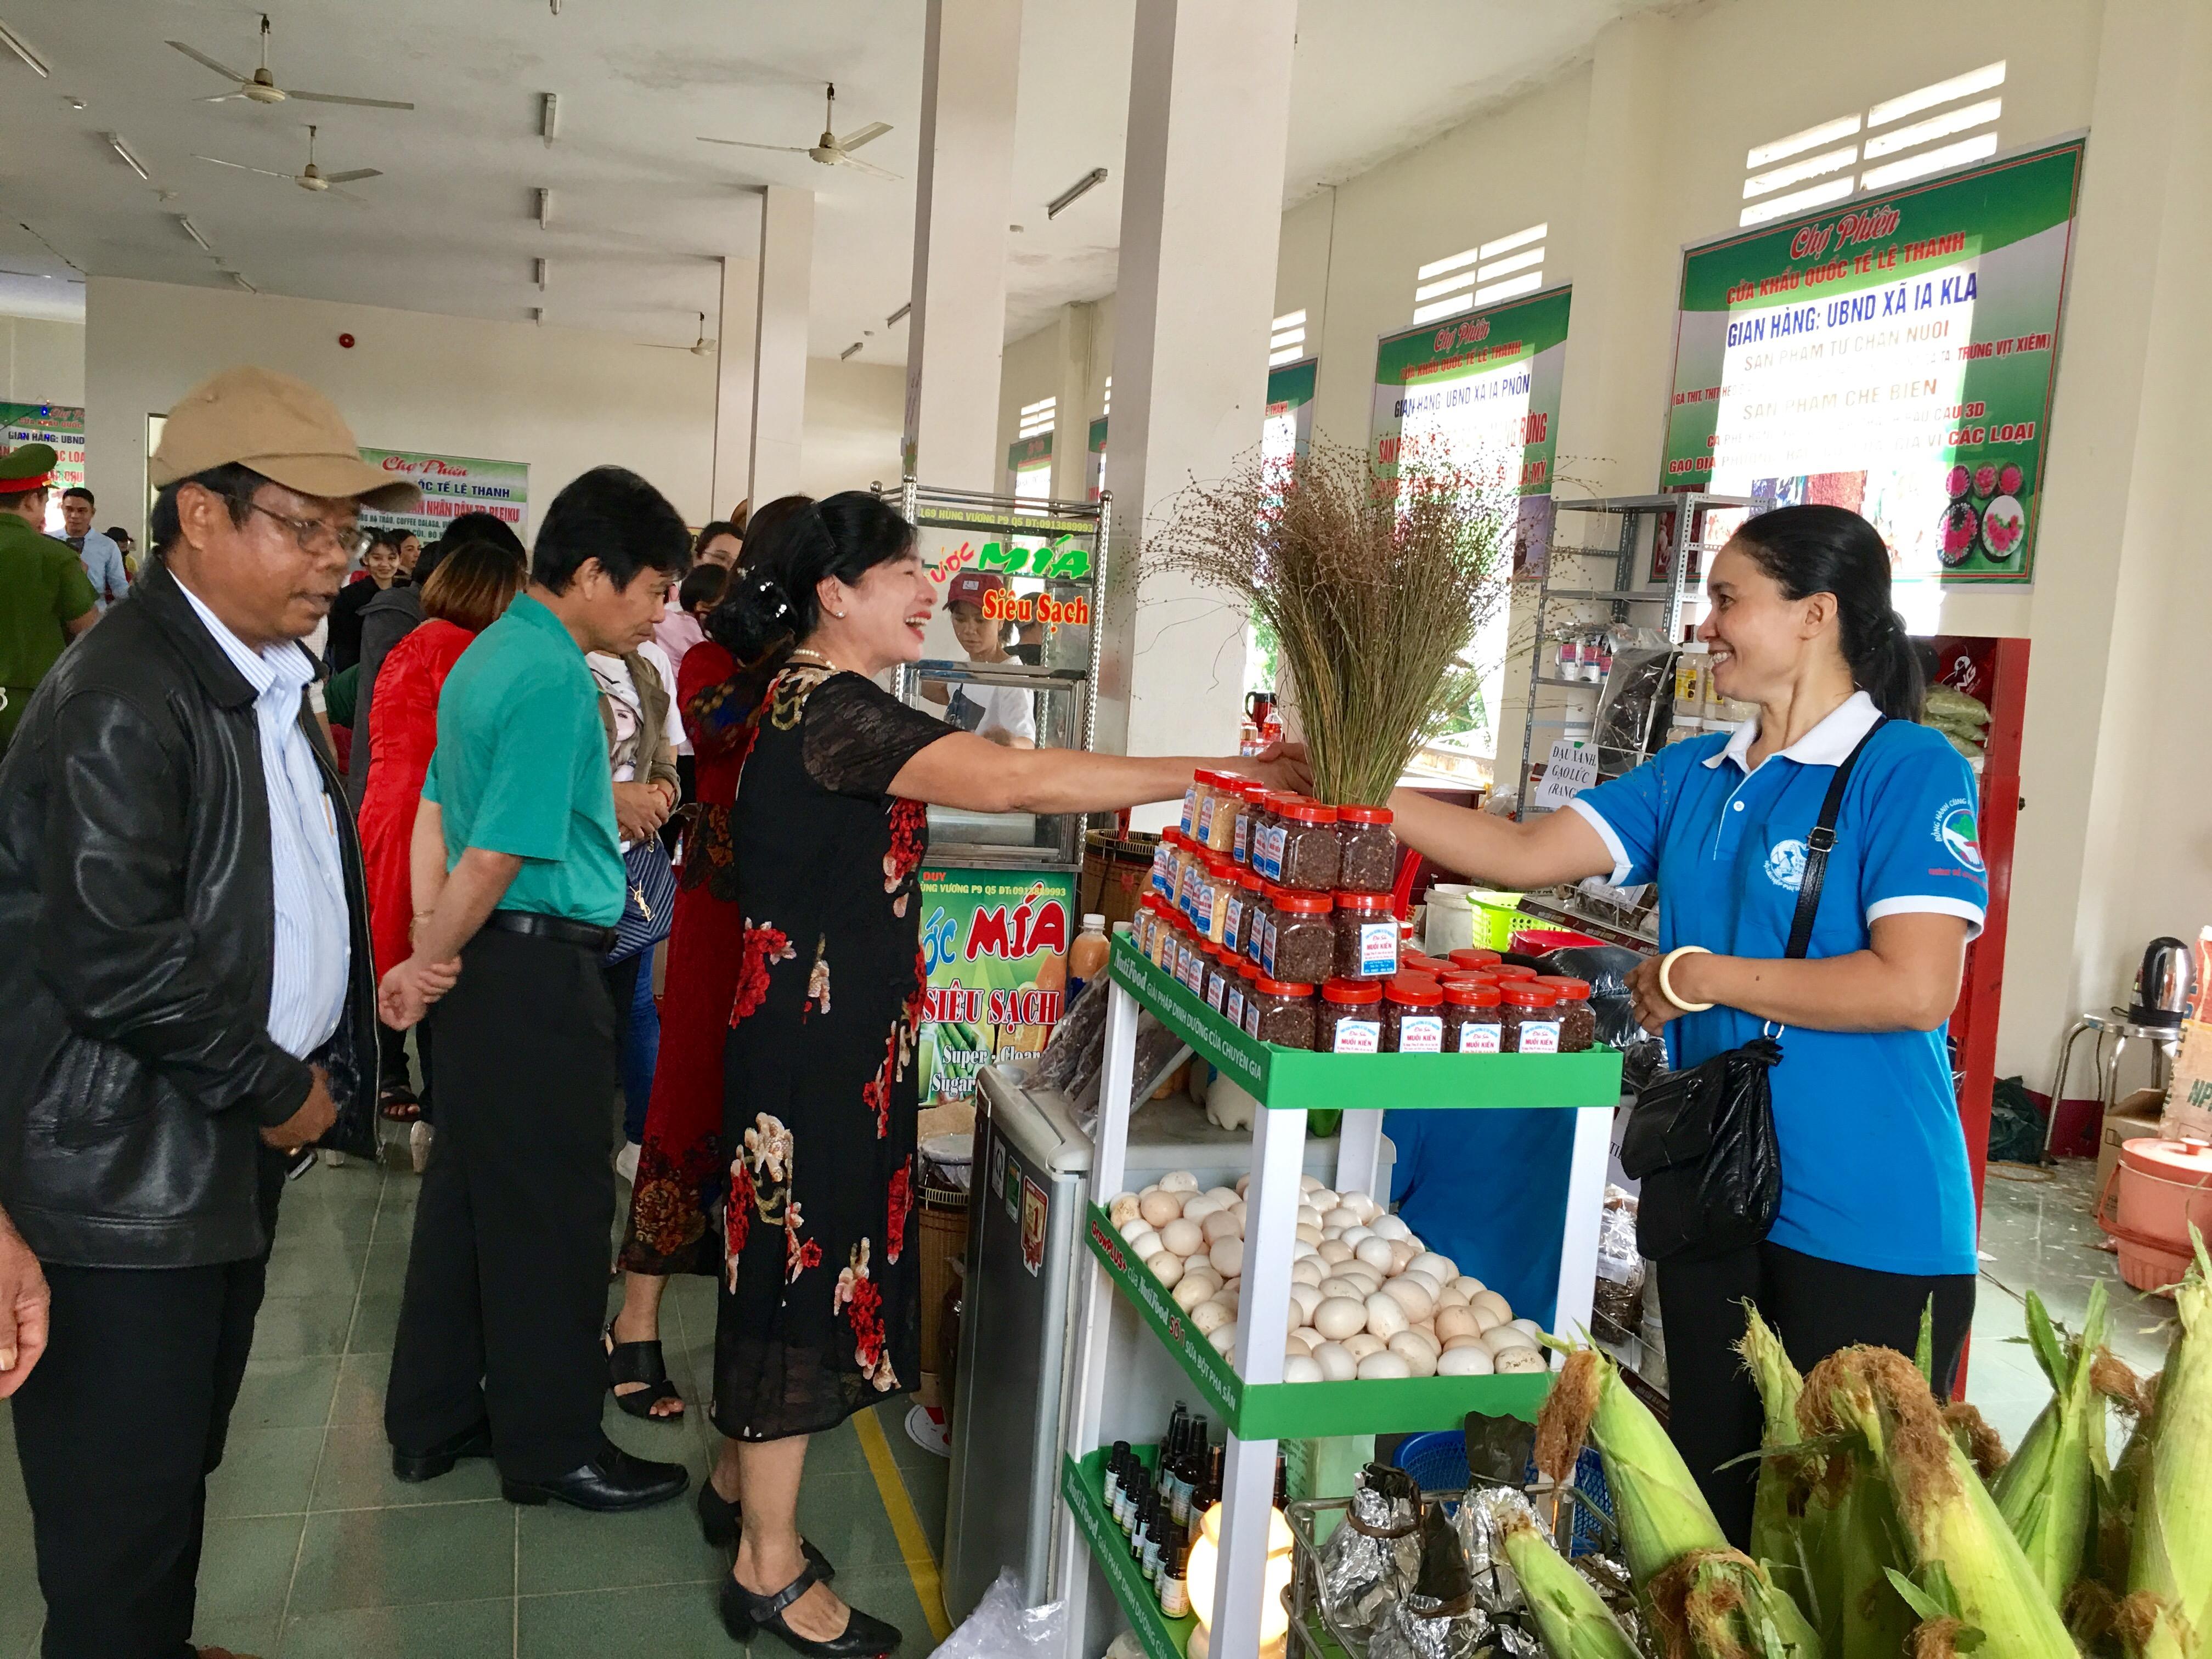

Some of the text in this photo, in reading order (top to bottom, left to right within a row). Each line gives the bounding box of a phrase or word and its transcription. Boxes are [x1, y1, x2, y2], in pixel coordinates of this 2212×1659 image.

[1804, 255, 1848, 288] QUỐC
[1853, 248, 1873, 275] TẾ
[1877, 243, 1897, 271] LỆ
[1904, 232, 1966, 264] THANH
[1728, 272, 1978, 347] GIAN HÀNG: UBND XÃ IA KLA
[1491, 340, 1522, 360] THANH
[1996, 338, 2013, 358] VỊT
[2016, 332, 2052, 354] XIÊM)
[1394, 398, 1415, 417] GIAN
[1447, 387, 1471, 408] UBND
[1489, 381, 1498, 399] IA
[1502, 371, 1531, 397] PNÔN
[1705, 386, 1720, 402] THỊT
[1965, 402, 1985, 419] 3D
[8, 431, 30, 440] GIAN
[61, 435, 85, 444] UBND
[1520, 409, 1548, 448] RỪNG
[1948, 425, 1985, 446] CÁC
[1989, 422, 2036, 445] LOẠI
[1669, 455, 1716, 476] GẠO ĐỊA
[437, 480, 450, 493] TẾ
[454, 483, 467, 496] LỆ
[472, 486, 510, 498] THANH
[939, 507, 963, 521] HÙNG
[966, 511, 995, 524] VƯƠNG
[997, 516, 1009, 525] P9
[1011, 517, 1023, 528] Q5
[978, 534, 1091, 579] MÍA
[982, 588, 1090, 634] Siêu Sạch
[920, 881, 938, 893] ÙNG
[940, 883, 969, 894] VƯƠNG
[971, 885, 983, 894] P9
[985, 885, 997, 895] Q5
[964, 880, 1067, 963] MÍA
[922, 978, 1060, 1034] SIÊU SẠCH
[1114, 948, 1148, 991] NutiFood
[1172, 1002, 1187, 1024] DINH
[1222, 1040, 1249, 1071] CHUYÊN
[1249, 1059, 1261, 1081] GIA
[943, 1045, 988, 1069] Super
[932, 1073, 976, 1097] Sugar
[2187, 1078, 2212, 1112] NP
[1138, 1276, 1170, 1326] NutiFood
[1197, 1356, 1210, 1377] BỘT
[1209, 1369, 1222, 1392] PHA
[1066, 1472, 1099, 1539] NutiFood
